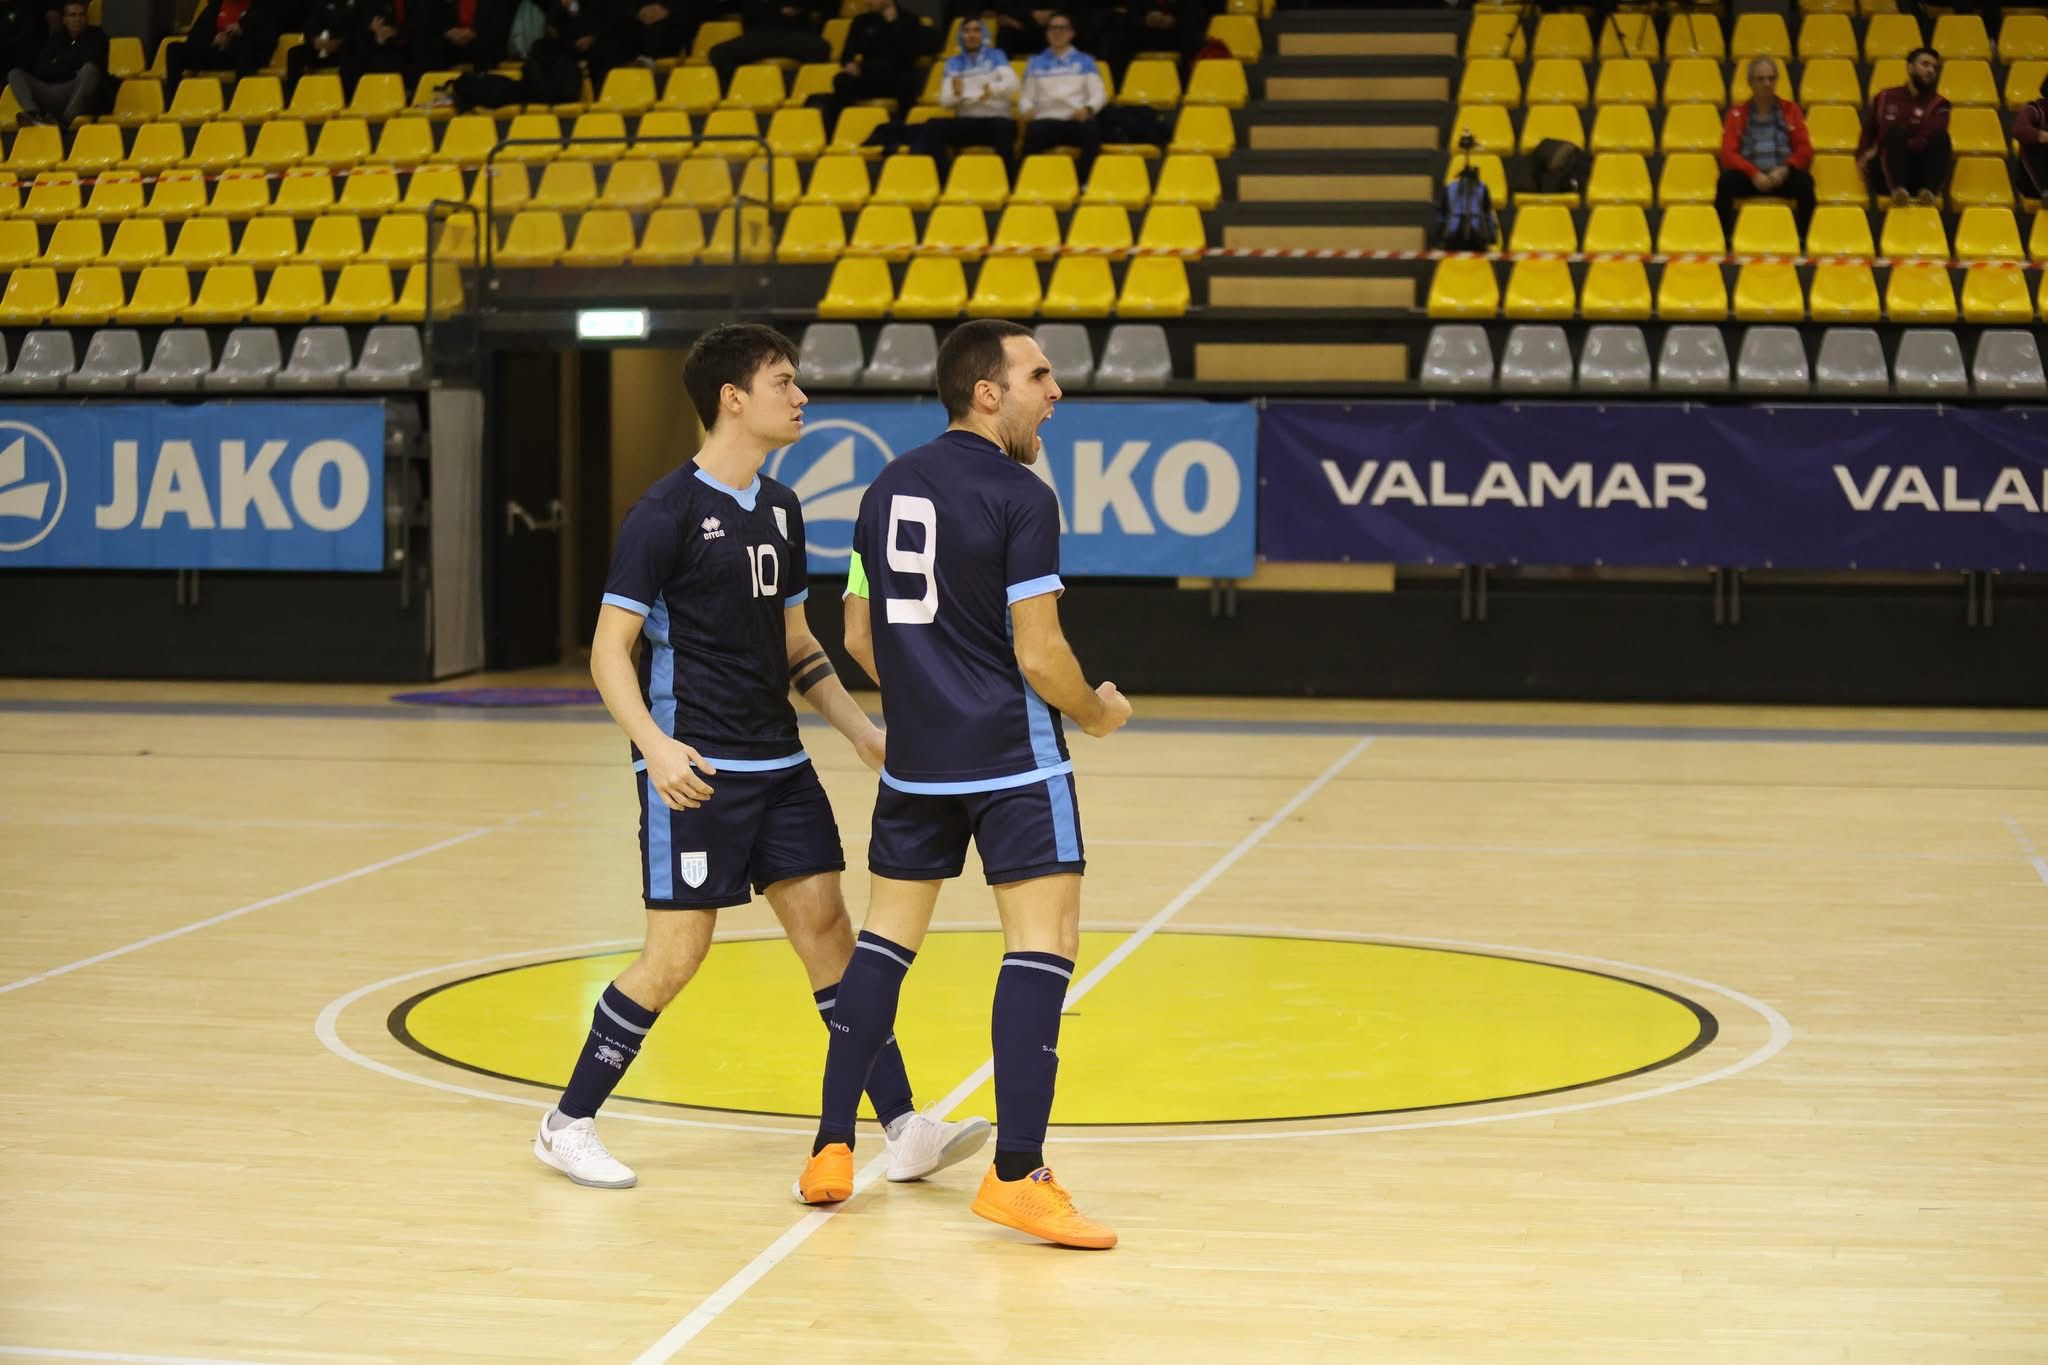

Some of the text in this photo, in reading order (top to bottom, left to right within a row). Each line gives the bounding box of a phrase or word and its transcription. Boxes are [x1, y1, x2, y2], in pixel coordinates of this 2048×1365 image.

[95, 438, 370, 532] JAKO
[1322, 459, 1708, 510] VALAMAR
[1832, 465, 2048, 513] VALA
[746, 544, 779, 598] 10
[886, 494, 939, 624] 9
